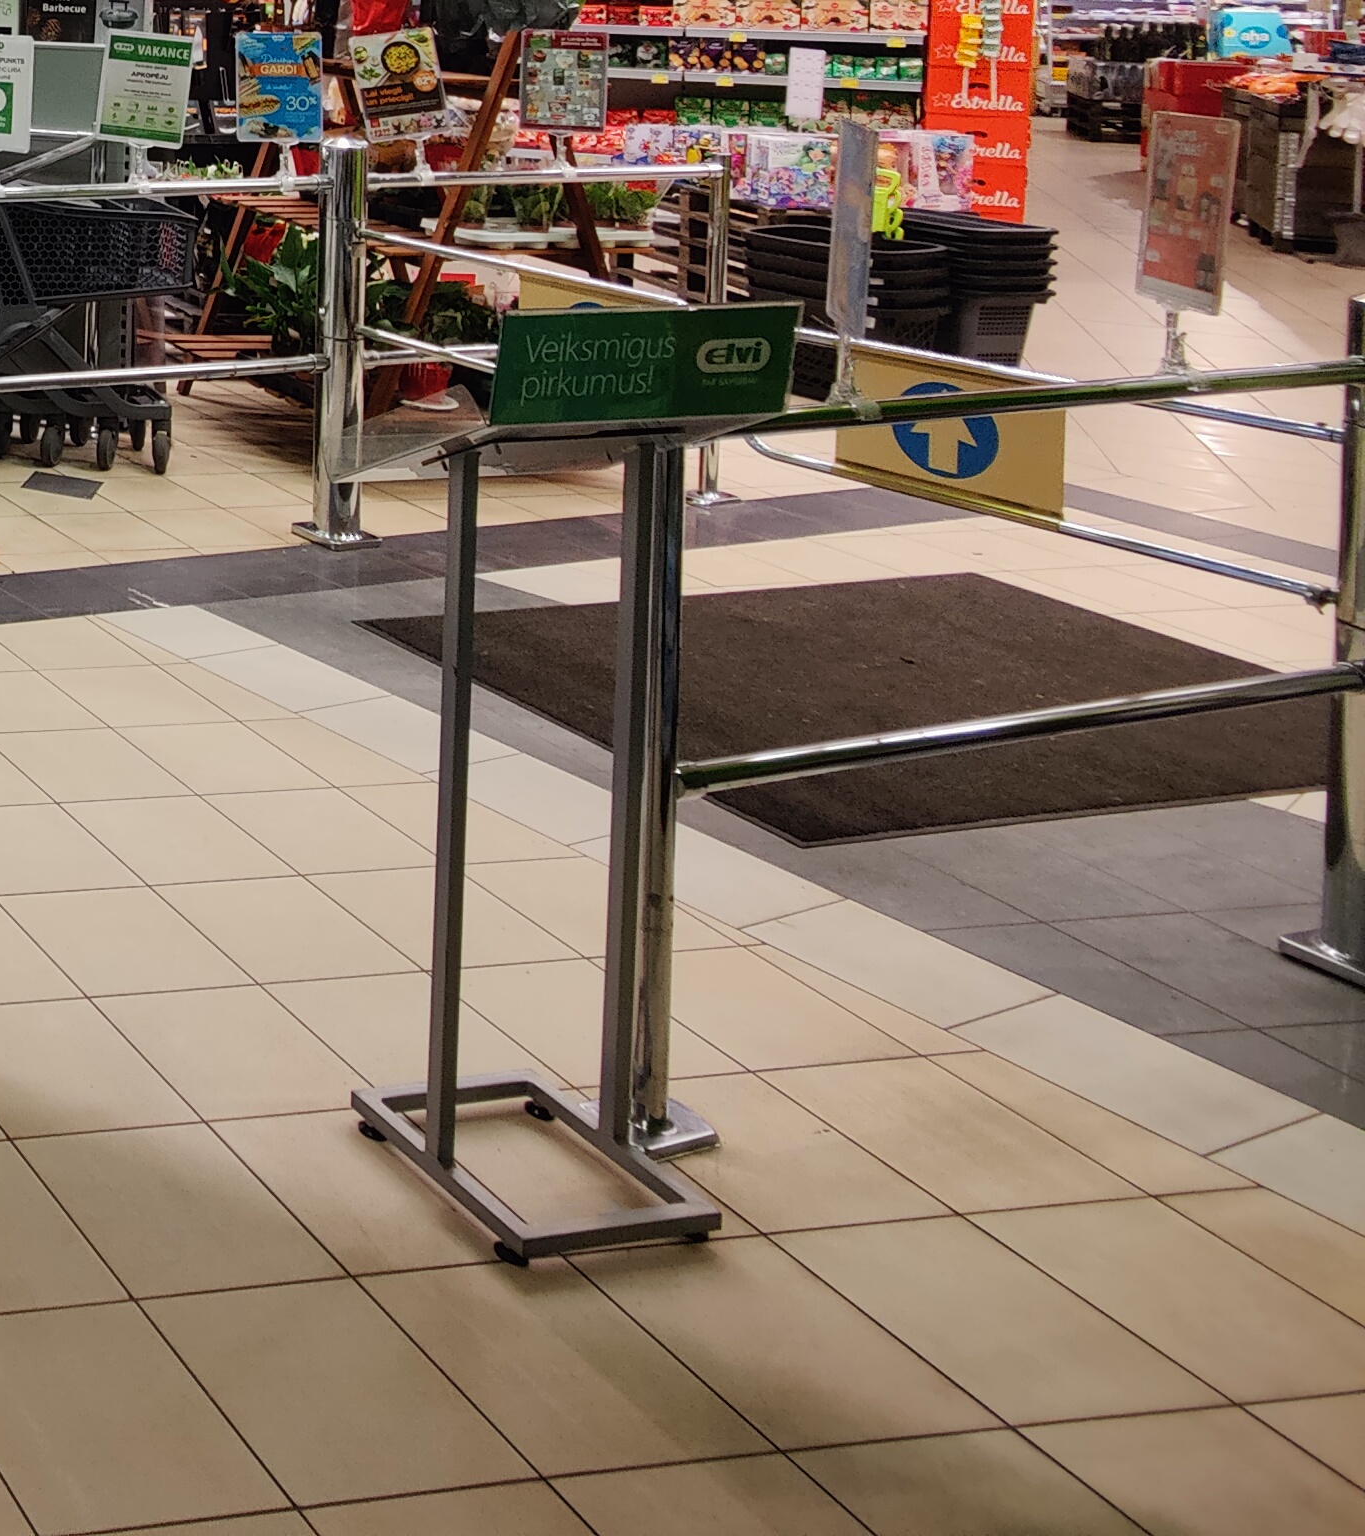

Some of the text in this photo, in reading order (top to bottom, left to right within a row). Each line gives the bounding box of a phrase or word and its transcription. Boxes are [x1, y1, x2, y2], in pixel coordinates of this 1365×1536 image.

[42, 3, 87, 14] Barbecue
[138, 44, 190, 60] VAKANCE
[131, 71, 169, 80] APKOPĒJU
[260, 65, 298, 75] GARDI
[285, 95, 317, 111] 30%
[526, 331, 676, 366] Veiksmīgus
[520, 366, 654, 406] pirkumus!
